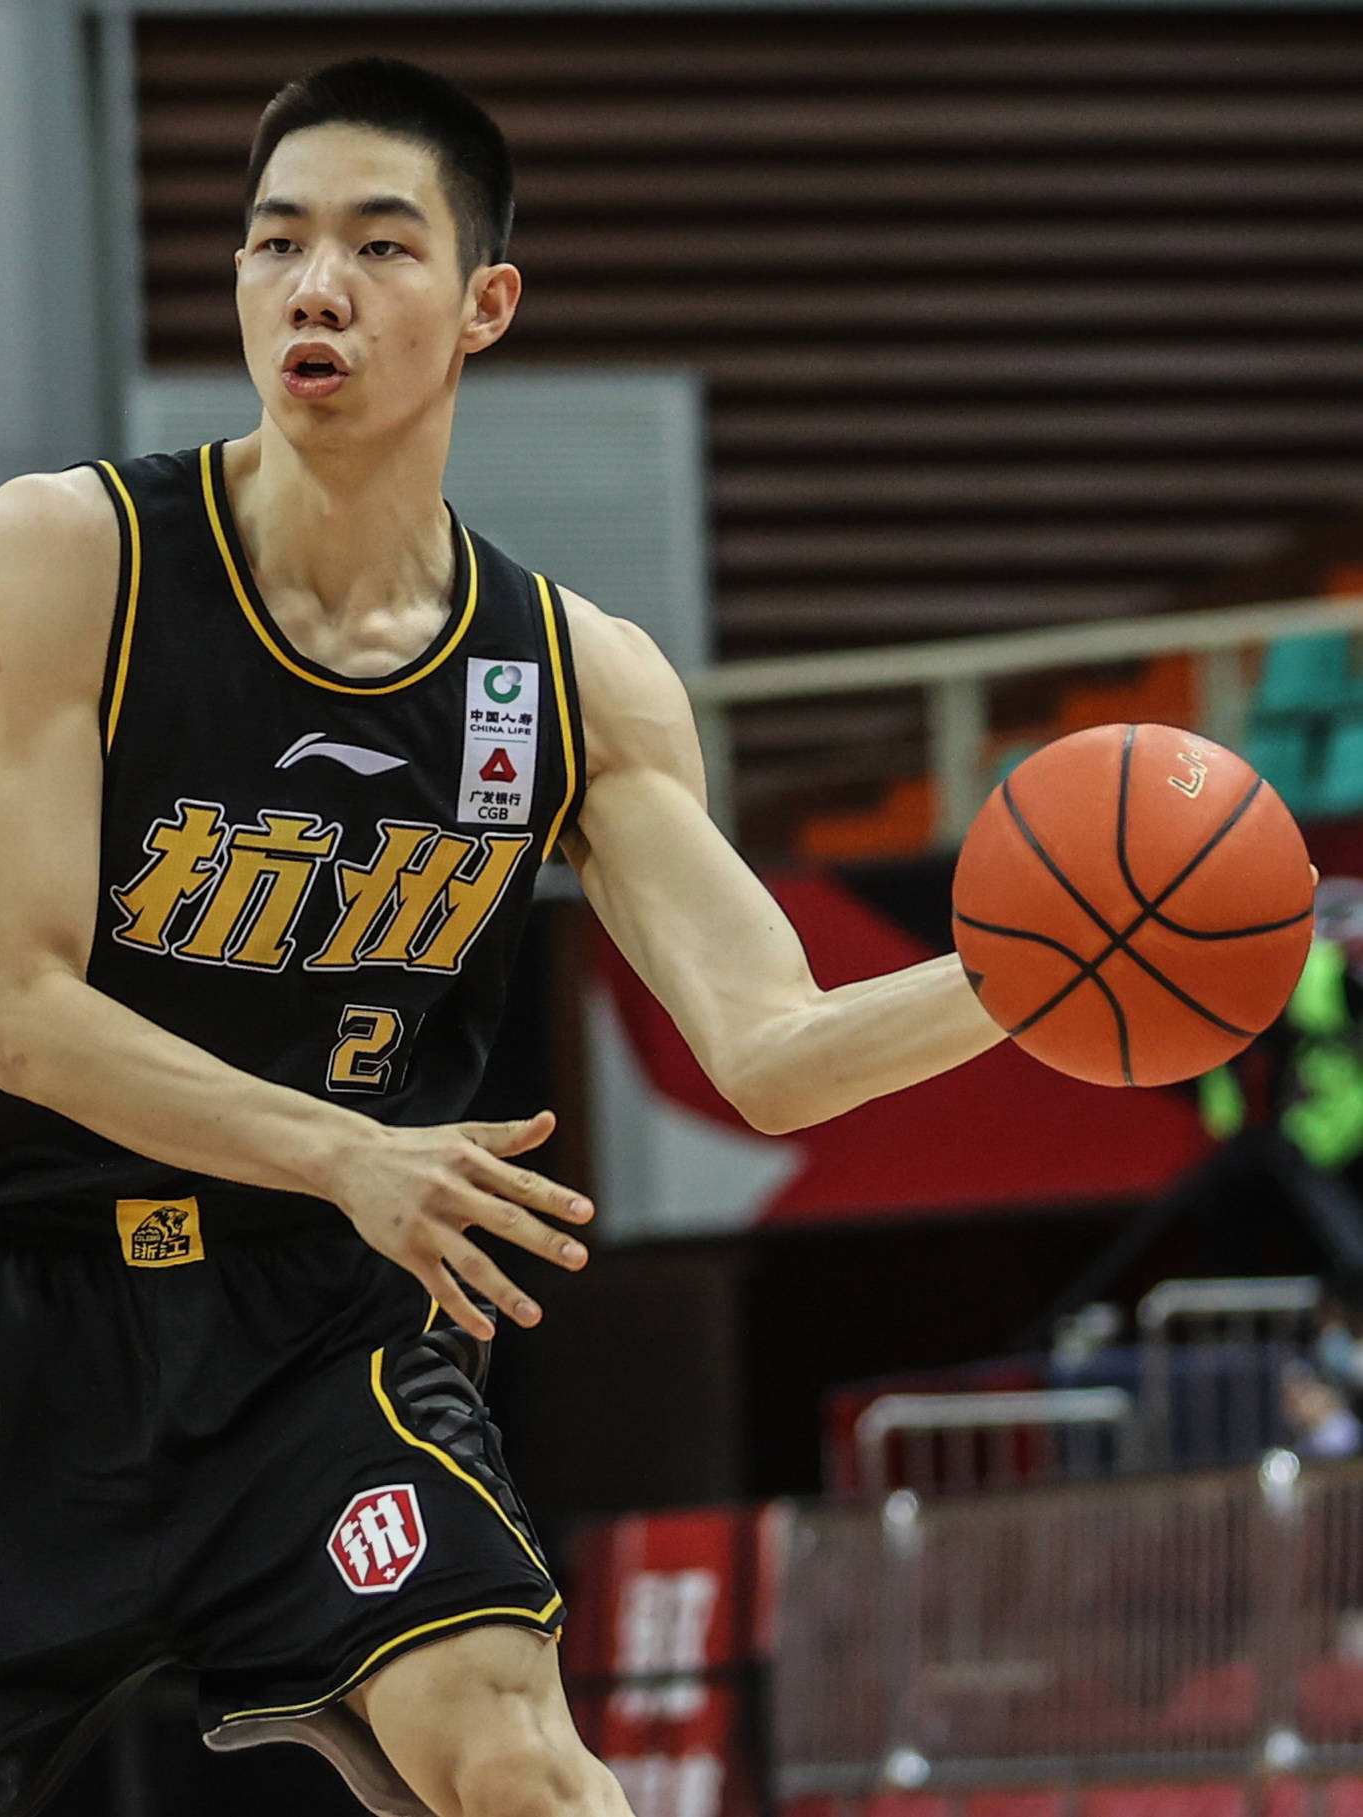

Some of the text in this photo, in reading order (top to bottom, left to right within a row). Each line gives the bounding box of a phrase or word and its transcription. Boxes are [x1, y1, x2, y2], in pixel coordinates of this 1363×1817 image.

[469, 708, 533, 726] 中国人寿
[469, 723, 532, 736] CHINA LIFE
[469, 790, 522, 807] 广发银行
[477, 806, 509, 821] CGB
[110, 798, 533, 974] 杭州
[326, 1003, 404, 1094] 2
[134, 1237, 188, 1260] 浙江
